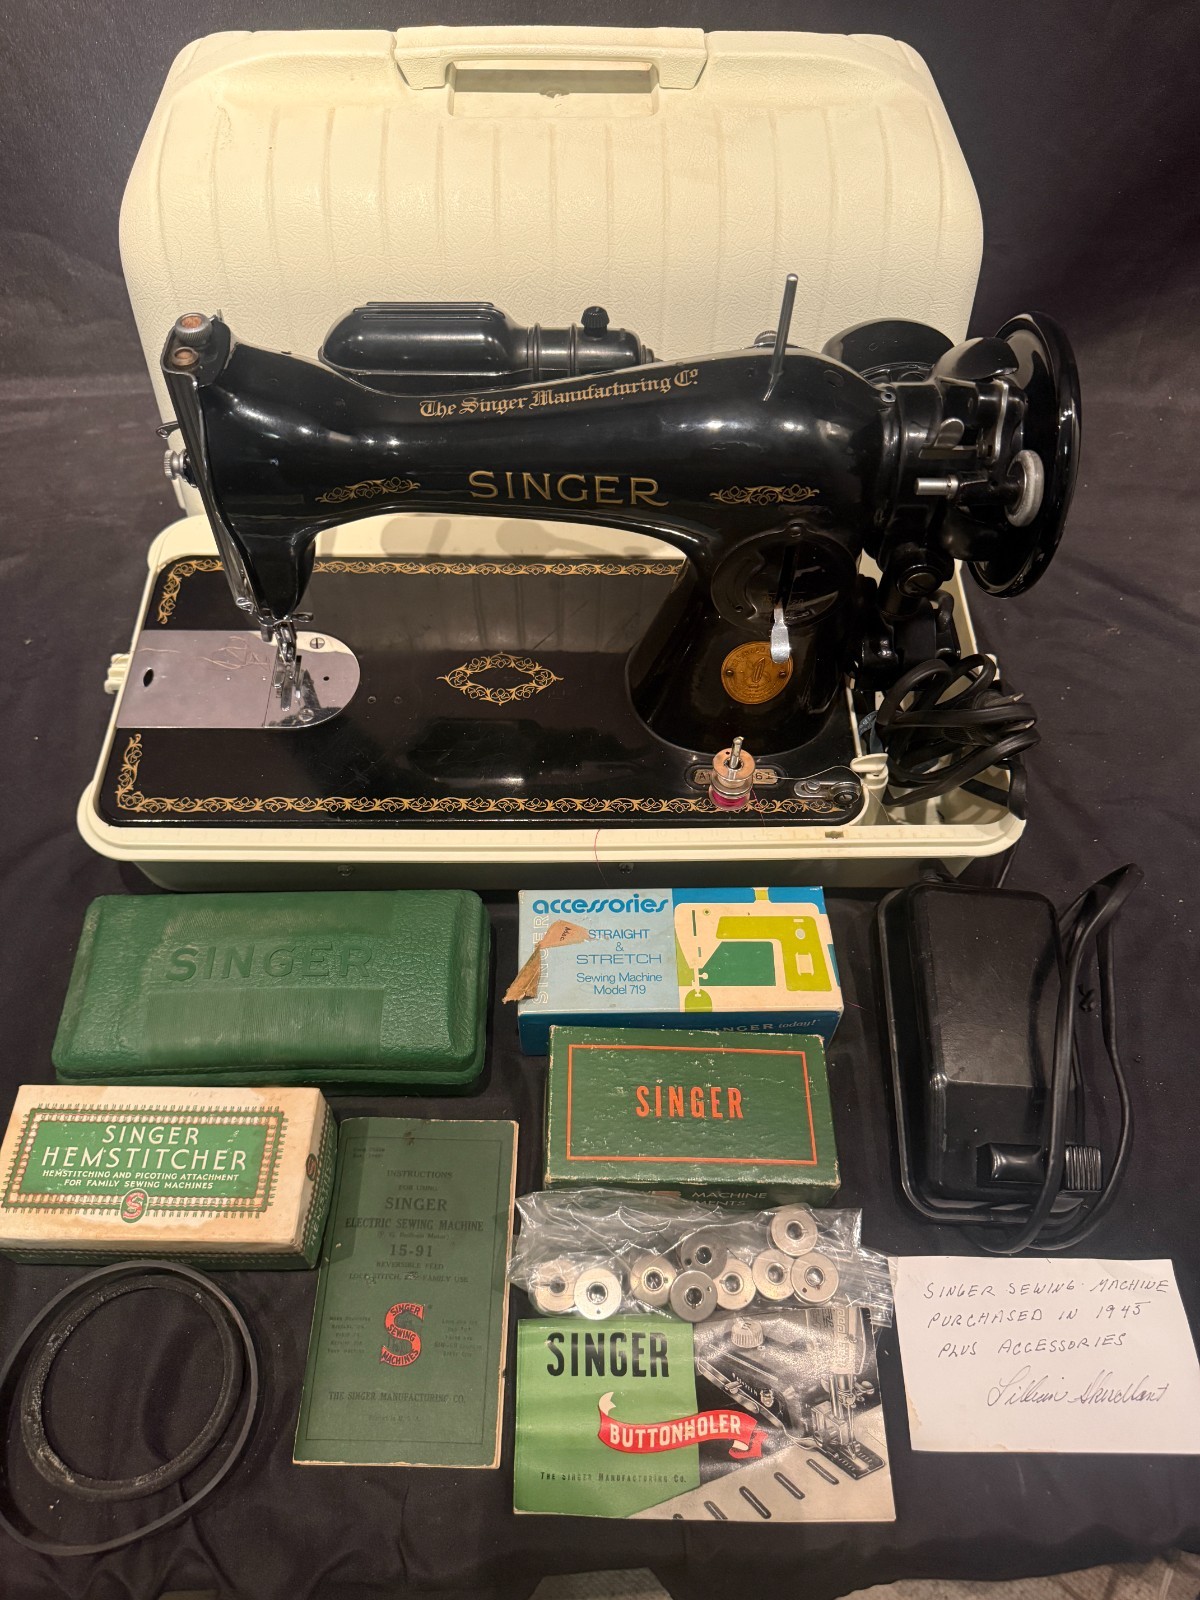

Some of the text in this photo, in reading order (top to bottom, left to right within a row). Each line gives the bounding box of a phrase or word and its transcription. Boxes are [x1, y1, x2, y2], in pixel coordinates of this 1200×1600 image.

[420, 399, 455, 418] The
[459, 396, 528, 415] Singer
[529, 377, 671, 409] Manufacturing
[468, 470, 669, 507] SINGER
[532, 893, 669, 914] accessories
[588, 929, 650, 939] STRAIGHT
[615, 941, 624, 951] &
[164, 942, 374, 981] SINGER
[576, 953, 662, 964] STRETCH
[576, 972, 663, 984] Sewing Machine
[593, 984, 647, 995] Model 719
[635, 1085, 744, 1119] SINGER
[102, 1125, 199, 1145] SINGER
[41, 1146, 247, 1171] HEMSTITCHER
[42, 1169, 239, 1181] HEMSTITCHING AND PICOTING ATTACHMENT
[86, 1179, 120, 1187] FAMILY
[124, 1180, 160, 1188] SEWING
[164, 1181, 214, 1189] MACHINES
[691, 1191, 768, 1199] MACHINE
[384, 1197, 448, 1211] SINGER
[345, 1217, 484, 1231] ELECTRIC SEWING MACHINE
[390, 1244, 433, 1257] 15-91
[923, 1278, 1169, 1299] SINGER SEWING MACHINE
[390, 1303, 421, 1316] SINGER
[927, 1301, 1151, 1328] PURCHASED IN 1945
[387, 1324, 416, 1342] SEWING
[937, 1332, 1127, 1358] PLUS ACCESSORIES
[381, 1348, 419, 1364] MACHINES
[546, 1332, 669, 1377] SINGER
[609, 1413, 742, 1449] BUTTONHOLER
